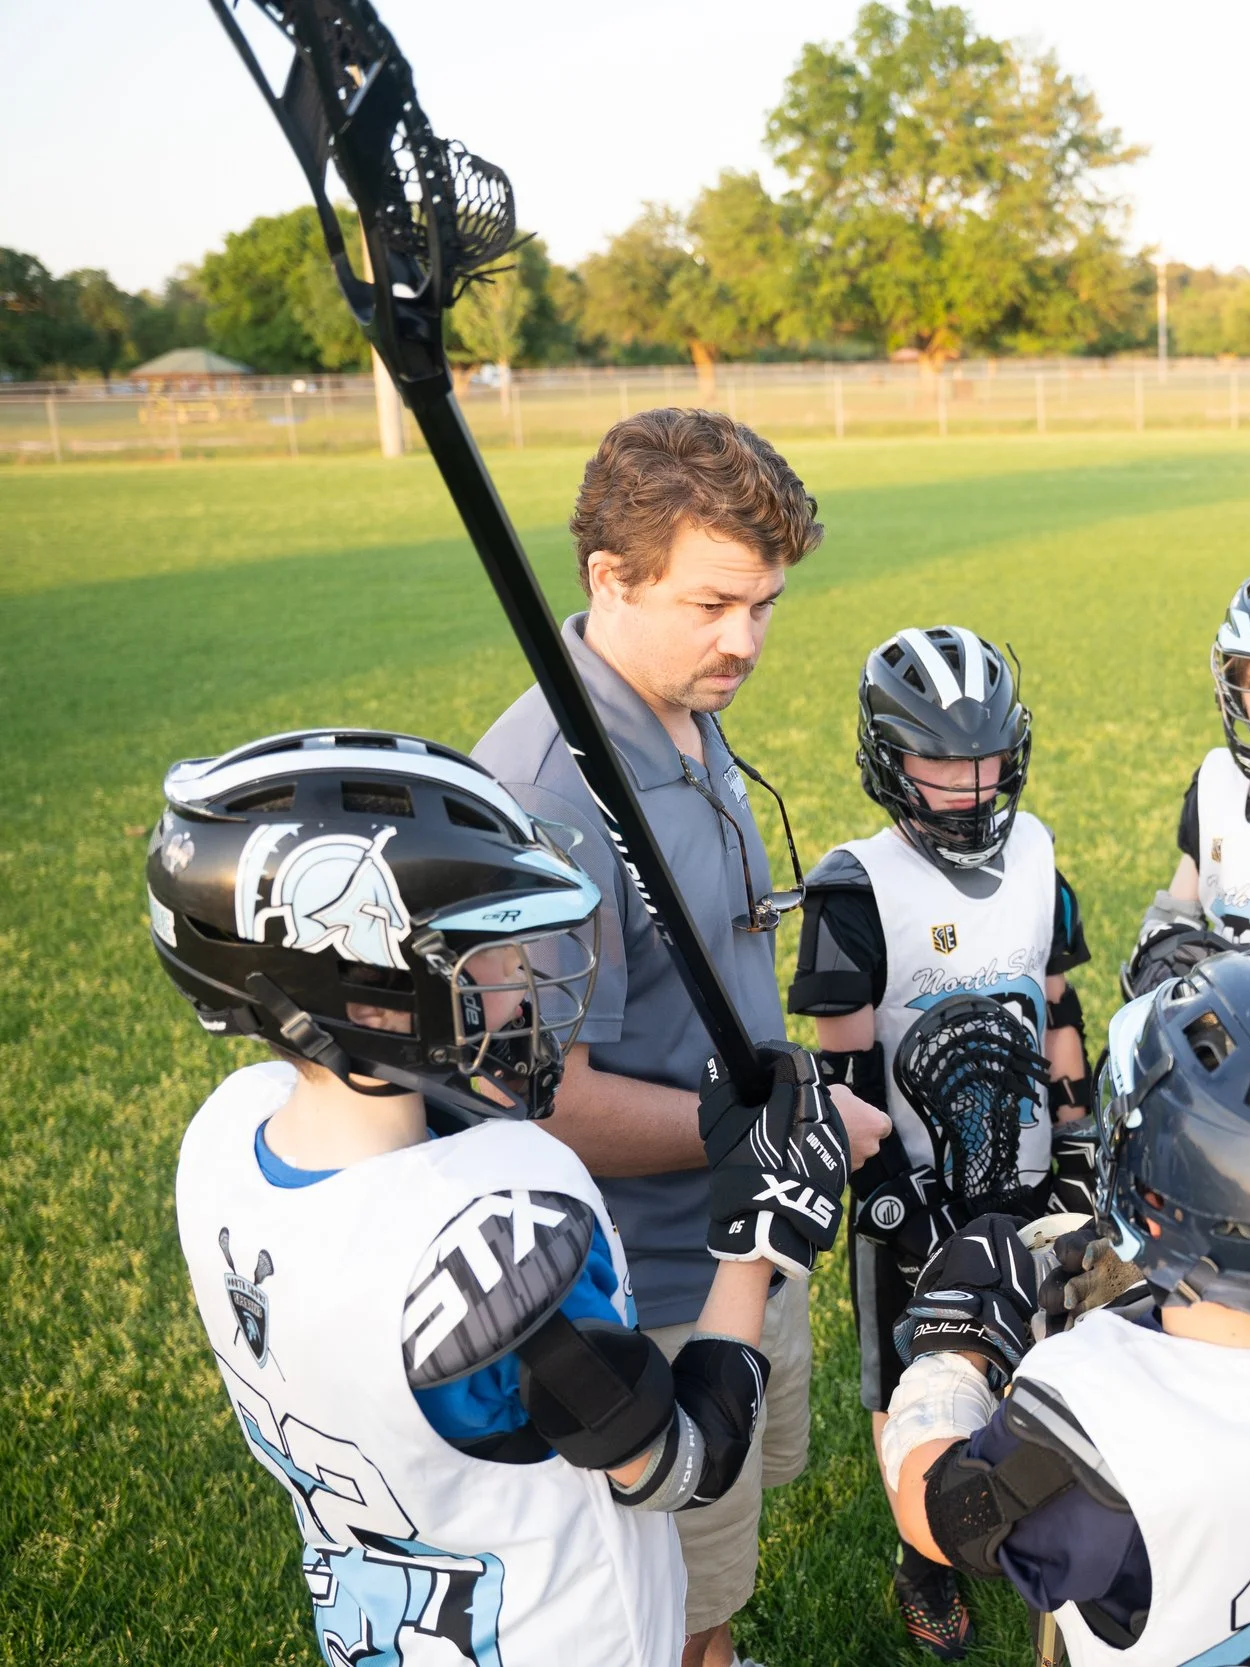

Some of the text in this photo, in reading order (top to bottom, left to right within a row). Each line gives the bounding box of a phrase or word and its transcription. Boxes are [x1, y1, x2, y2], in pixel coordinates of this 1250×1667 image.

[912, 957, 999, 996] North
[706, 1057, 720, 1084] STX
[805, 1132, 838, 1172] STALLION
[751, 1173, 837, 1230] STX
[728, 1219, 746, 1235] 50
[401, 1189, 568, 1371] STX
[678, 1453, 694, 1494] TOP
